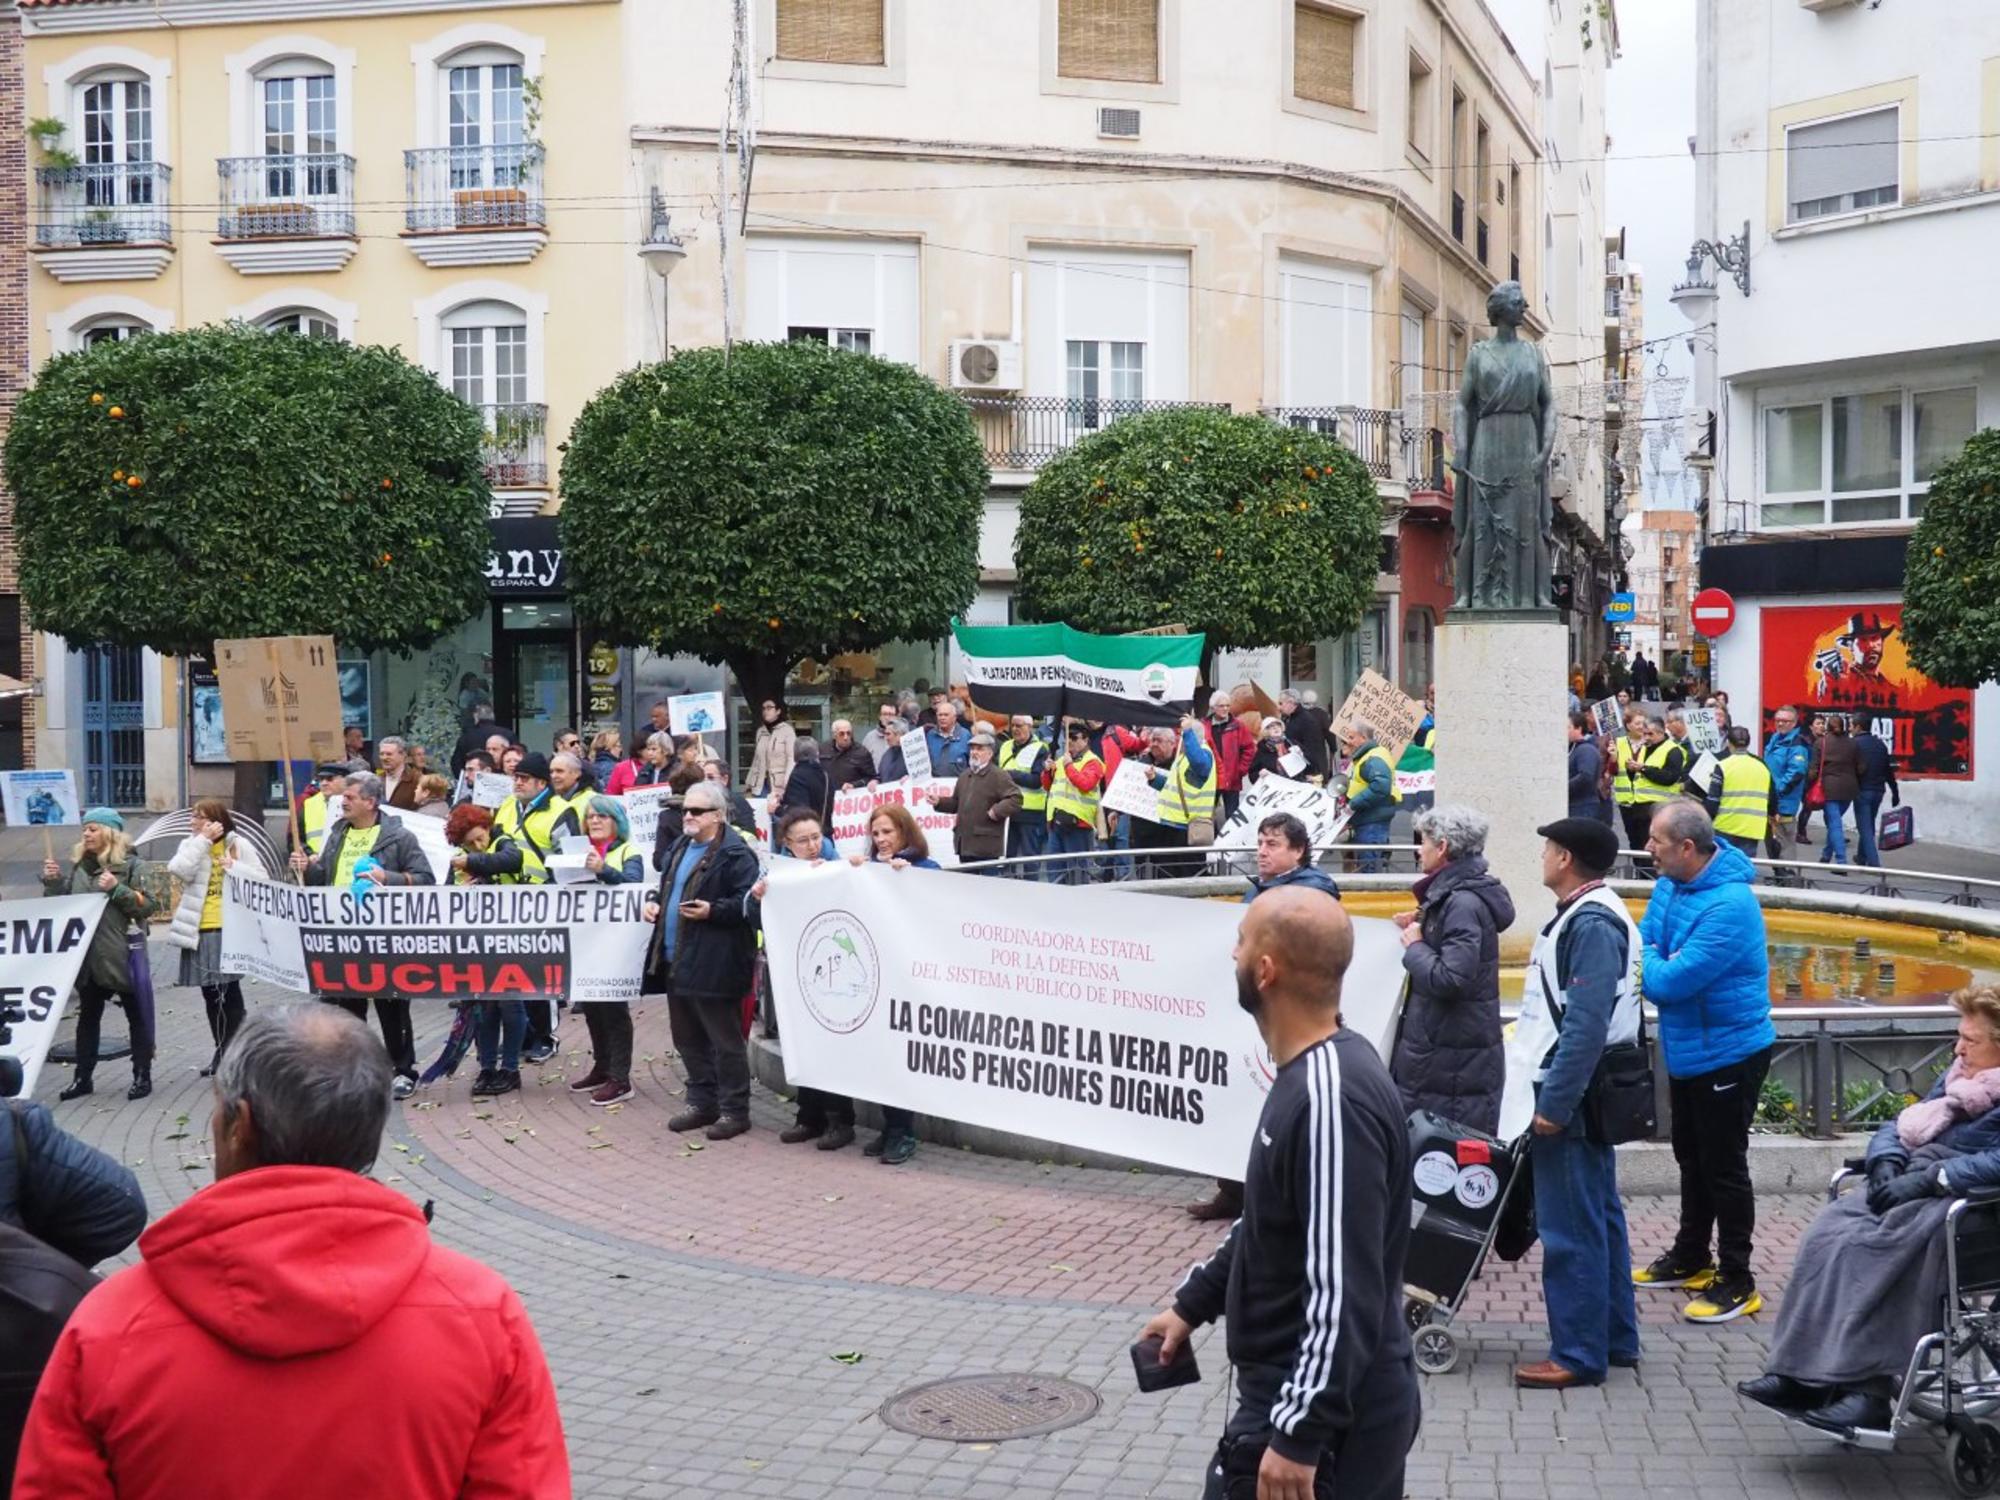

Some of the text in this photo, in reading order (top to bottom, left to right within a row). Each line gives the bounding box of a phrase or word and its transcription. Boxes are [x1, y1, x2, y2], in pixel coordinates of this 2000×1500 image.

[981, 666, 1038, 681] PLATAFORMA
[243, 879, 296, 921] DEFENSA
[296, 892, 335, 925] DEL
[340, 890, 441, 925] SISTEMA
[556, 889, 588, 923] DE
[0, 917, 86, 954] MA
[303, 930, 565, 954] QUE NO TE ROBEN LA PENSIÓN
[961, 922, 1155, 962] COORDINADORA ESTATAL
[991, 949, 1120, 982] POR LA DEFENSA
[911, 961, 942, 981] DEL
[946, 965, 1011, 990] SISTEMA
[1086, 985, 1108, 1004] DE
[1112, 988, 1206, 1018] PENSIONES
[889, 998, 912, 1033] LA
[918, 1003, 1034, 1053] COMARCA
[1041, 1021, 1069, 1058] DE
[1076, 1027, 1103, 1065] LA
[1109, 1032, 1171, 1077] VERA
[1178, 1044, 1229, 1087] POR
[907, 1040, 1204, 1125] UNAS PENSIONES DIGNAS
